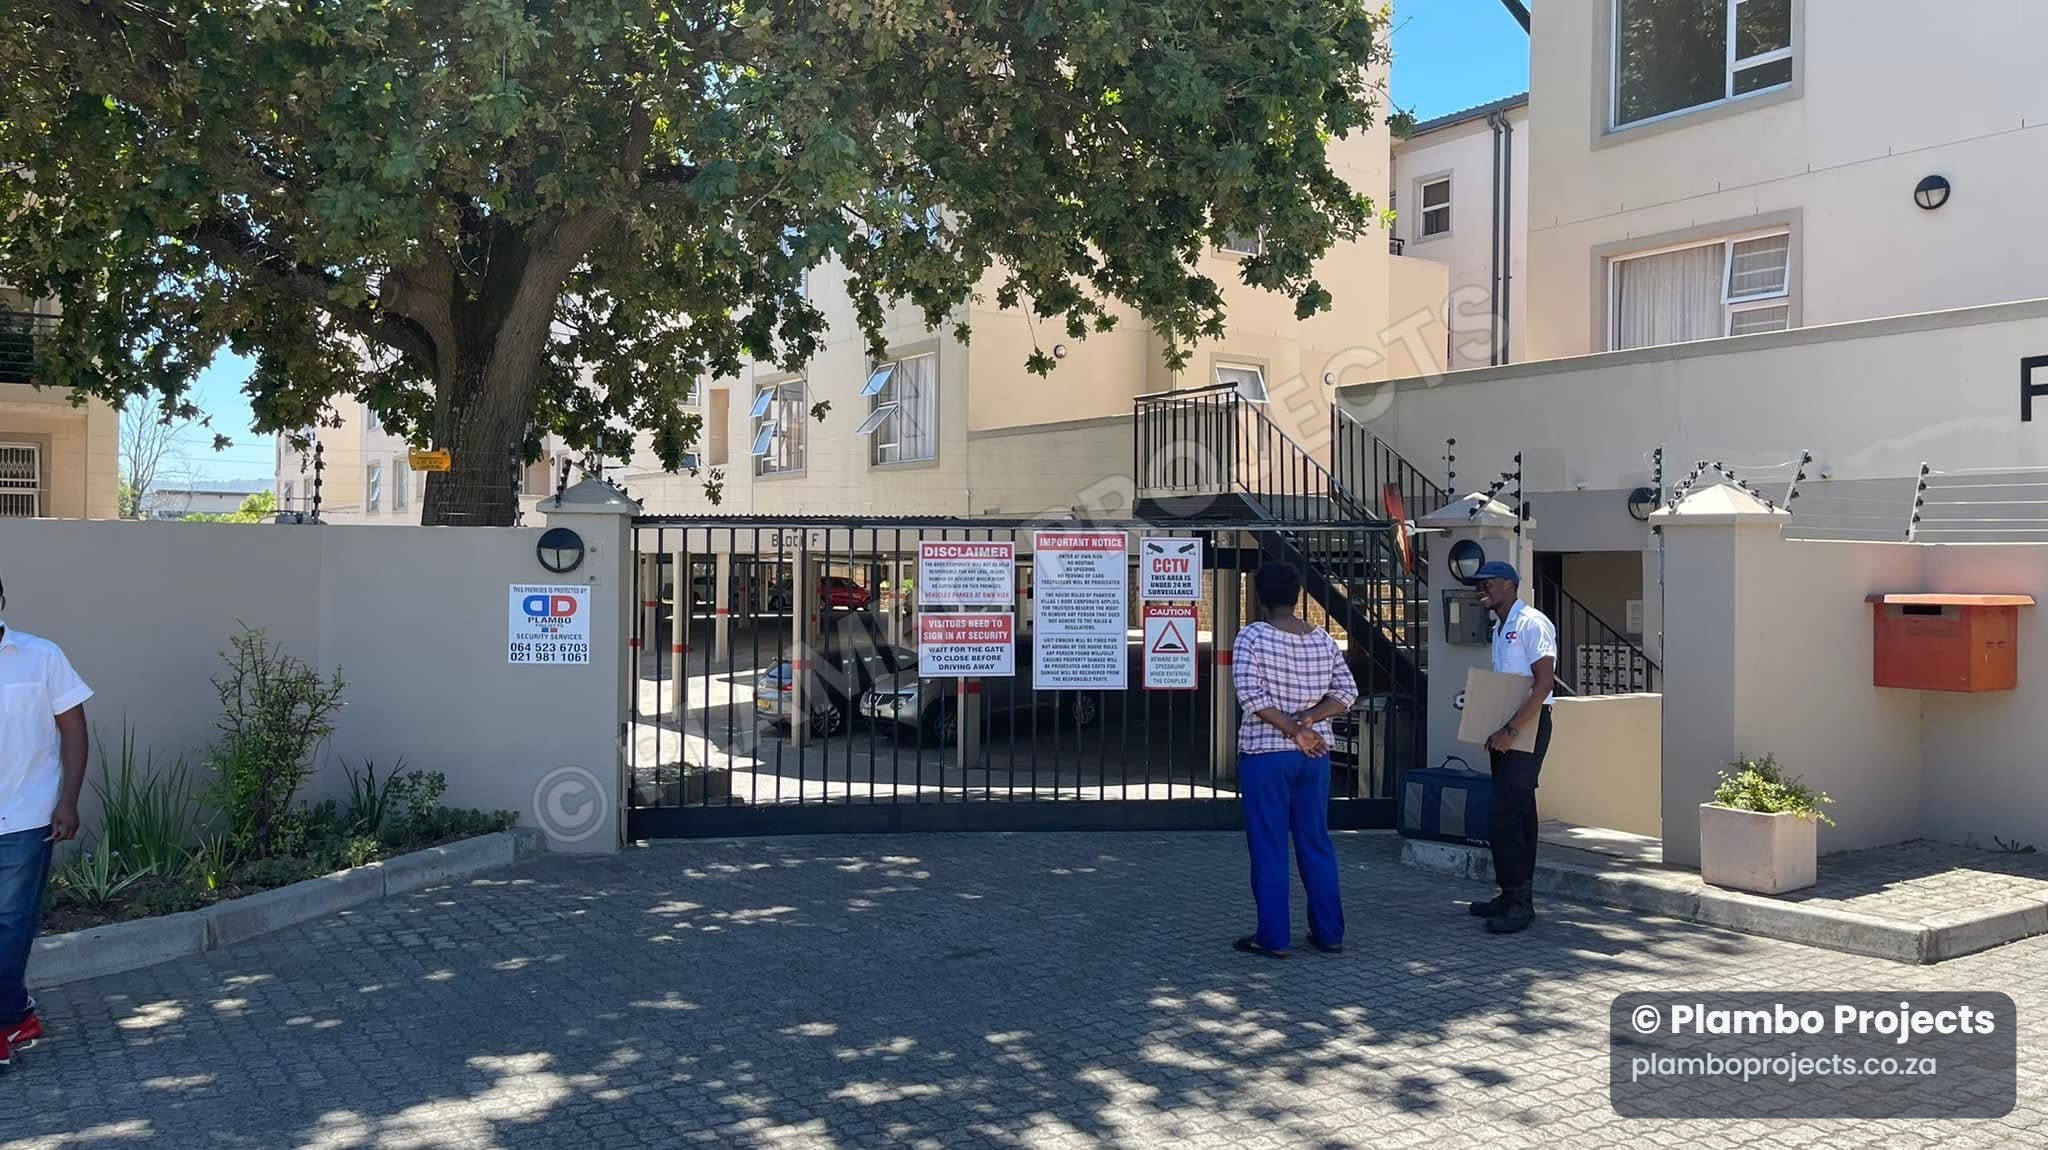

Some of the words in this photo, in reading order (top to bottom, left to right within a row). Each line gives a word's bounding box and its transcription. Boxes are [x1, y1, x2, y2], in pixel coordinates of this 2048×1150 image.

[1040, 538, 1089, 547] IMPORTANT
[1092, 538, 1122, 547] NOTICE
[924, 547, 1008, 557] DISCLAIMER
[1153, 558, 1189, 573] CCTV
[929, 620, 966, 628] VISITORS
[968, 620, 990, 628] NEED
[992, 620, 1002, 628] TO
[924, 632, 942, 640] SIGN
[945, 632, 954, 640] IN
[956, 632, 967, 640] AT
[968, 632, 1008, 640] SECURITY
[511, 643, 531, 651] 064
[536, 643, 556, 652] 523
[560, 643, 587, 652] 6703
[536, 653, 556, 661] 981
[562, 653, 587, 661] 1061
